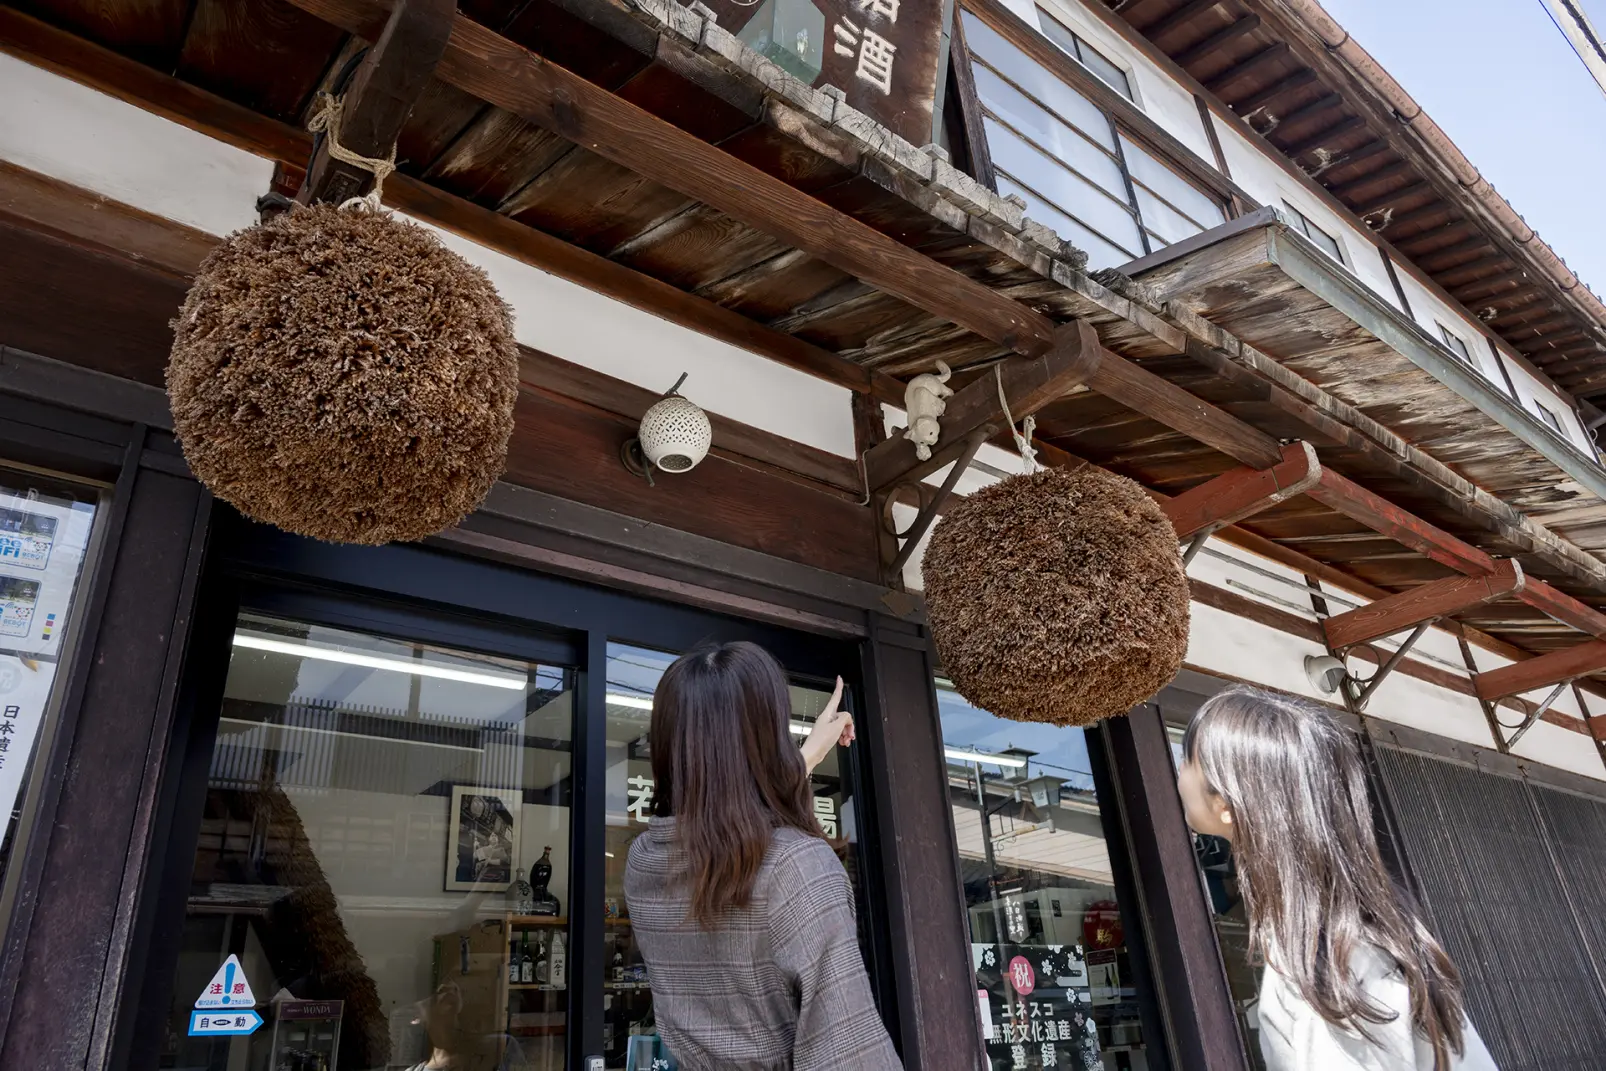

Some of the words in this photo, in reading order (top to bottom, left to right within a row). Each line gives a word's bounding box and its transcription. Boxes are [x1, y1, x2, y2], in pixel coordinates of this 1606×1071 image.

[1013, 963, 1032, 988] 祝
[1001, 1001, 1054, 1020] ユネスコ
[990, 1020, 1072, 1045] 無形文化遺産
